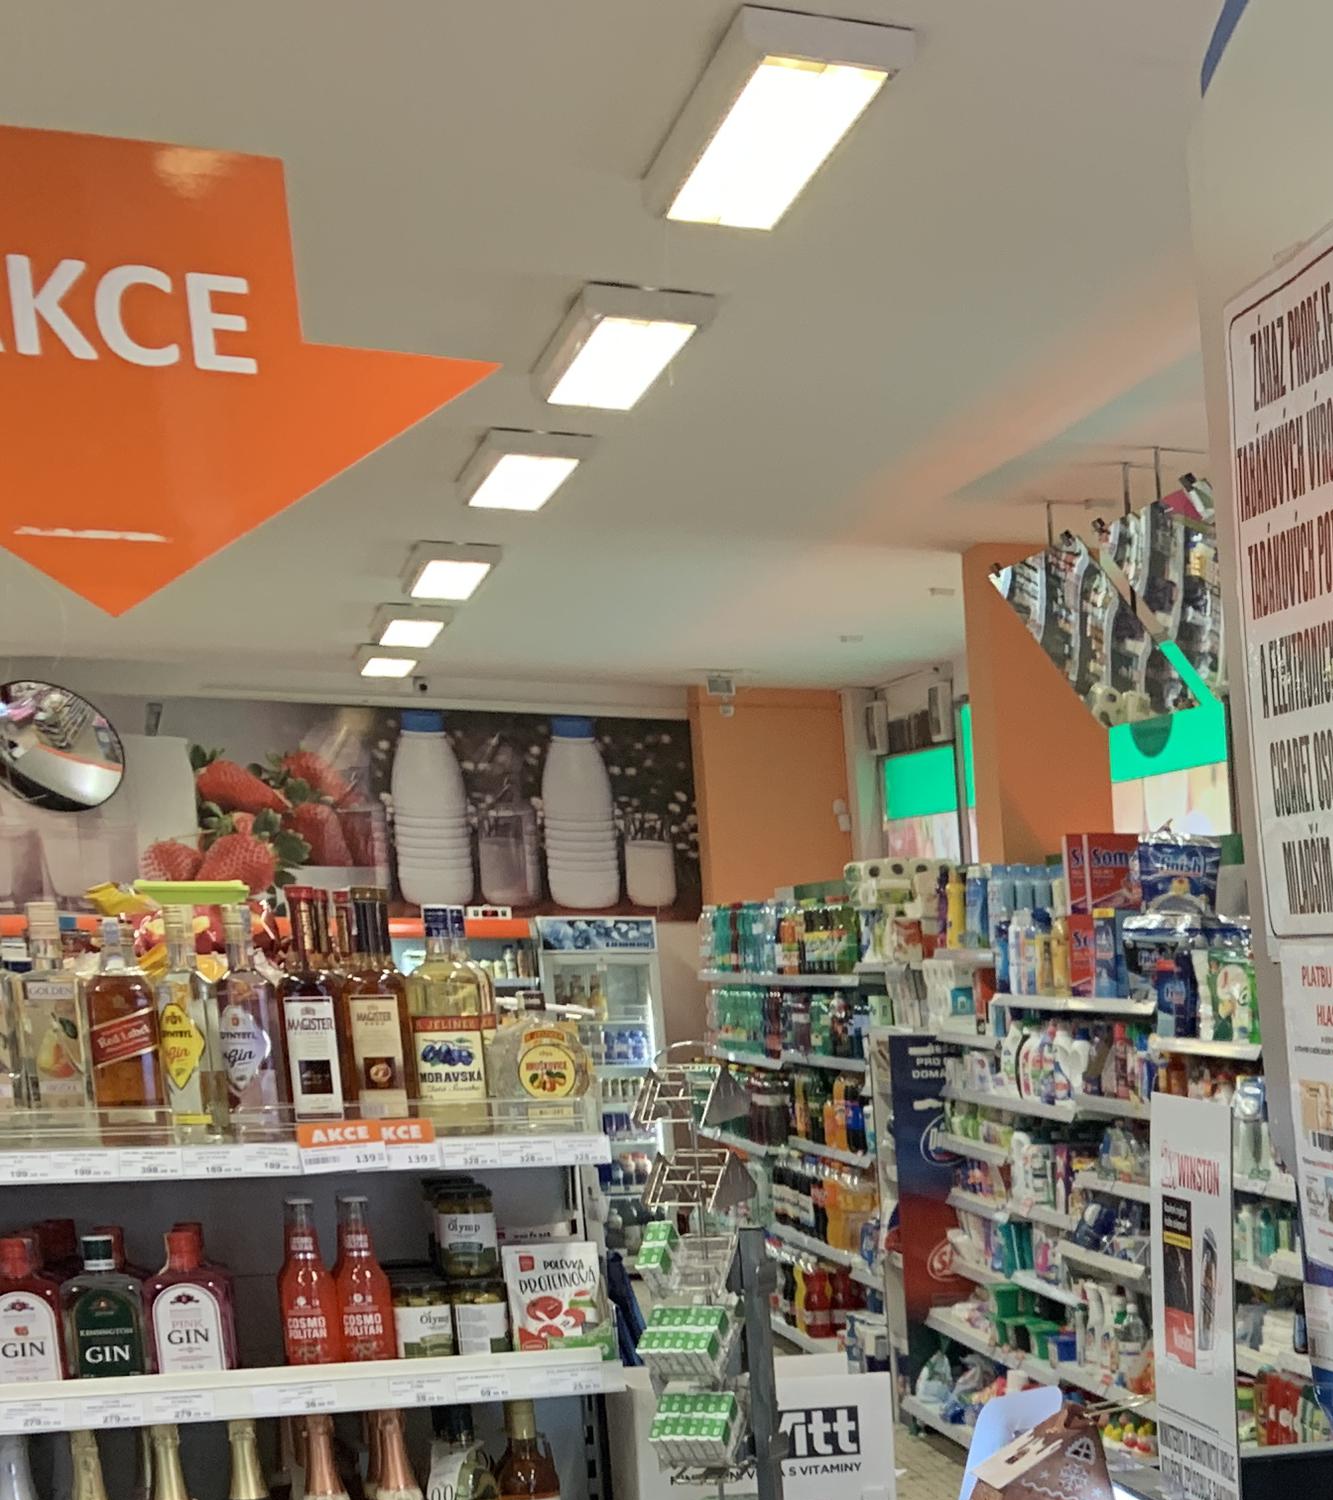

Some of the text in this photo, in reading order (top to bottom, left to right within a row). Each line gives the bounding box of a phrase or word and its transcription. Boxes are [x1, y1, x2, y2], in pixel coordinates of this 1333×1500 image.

[0, 254, 258, 374] KCE
[1250, 314, 1286, 411] ZÁKAZ
[1237, 407, 1305, 522] TABÁKOVÝCH
[1248, 510, 1315, 620] TABÁKOVÝCH
[1260, 644, 1269, 719] A
[1270, 735, 1314, 817] CIGARET
[1301, 965, 1332, 988] PLATBU
[287, 1017, 333, 1031] MAGISTER
[356, 1010, 391, 1022] MAGISTER
[311, 1126, 369, 1143] AKCE
[1177, 1155, 1220, 1196] WINSTON
[288, 1316, 326, 1329] COSMO
[343, 1313, 381, 1326] COSMO
[167, 1328, 210, 1345] GIN
[288, 1327, 328, 1339] POLITAN
[344, 1324, 384, 1336] POLITAN
[1, 1341, 46, 1358] GIN
[85, 1345, 131, 1363] GIN
[800, 1462, 862, 1476] VITAMINY
